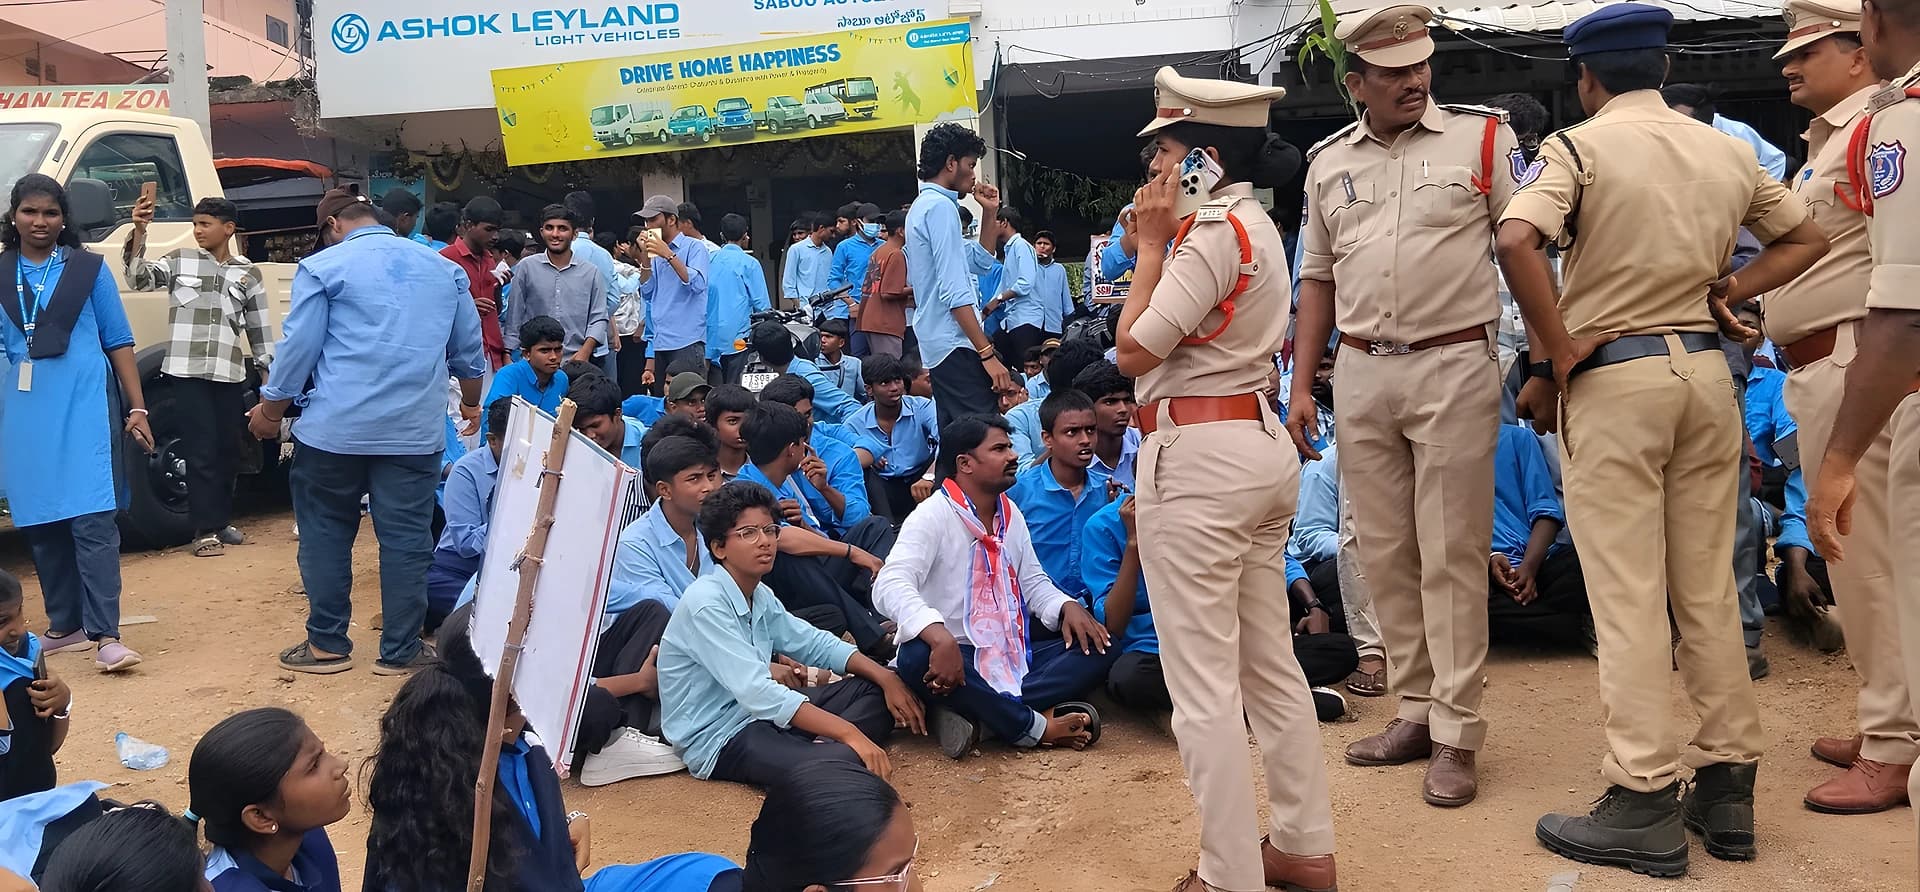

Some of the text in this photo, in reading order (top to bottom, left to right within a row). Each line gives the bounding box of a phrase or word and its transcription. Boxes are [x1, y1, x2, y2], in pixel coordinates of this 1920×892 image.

[376, 3, 680, 42] ASHOK LEYLAND
[535, 28, 680, 46] LIGHT VEHICLES
[620, 44, 841, 85] DRIVE HOME HAPPINESS
[62, 91, 109, 109] TEA
